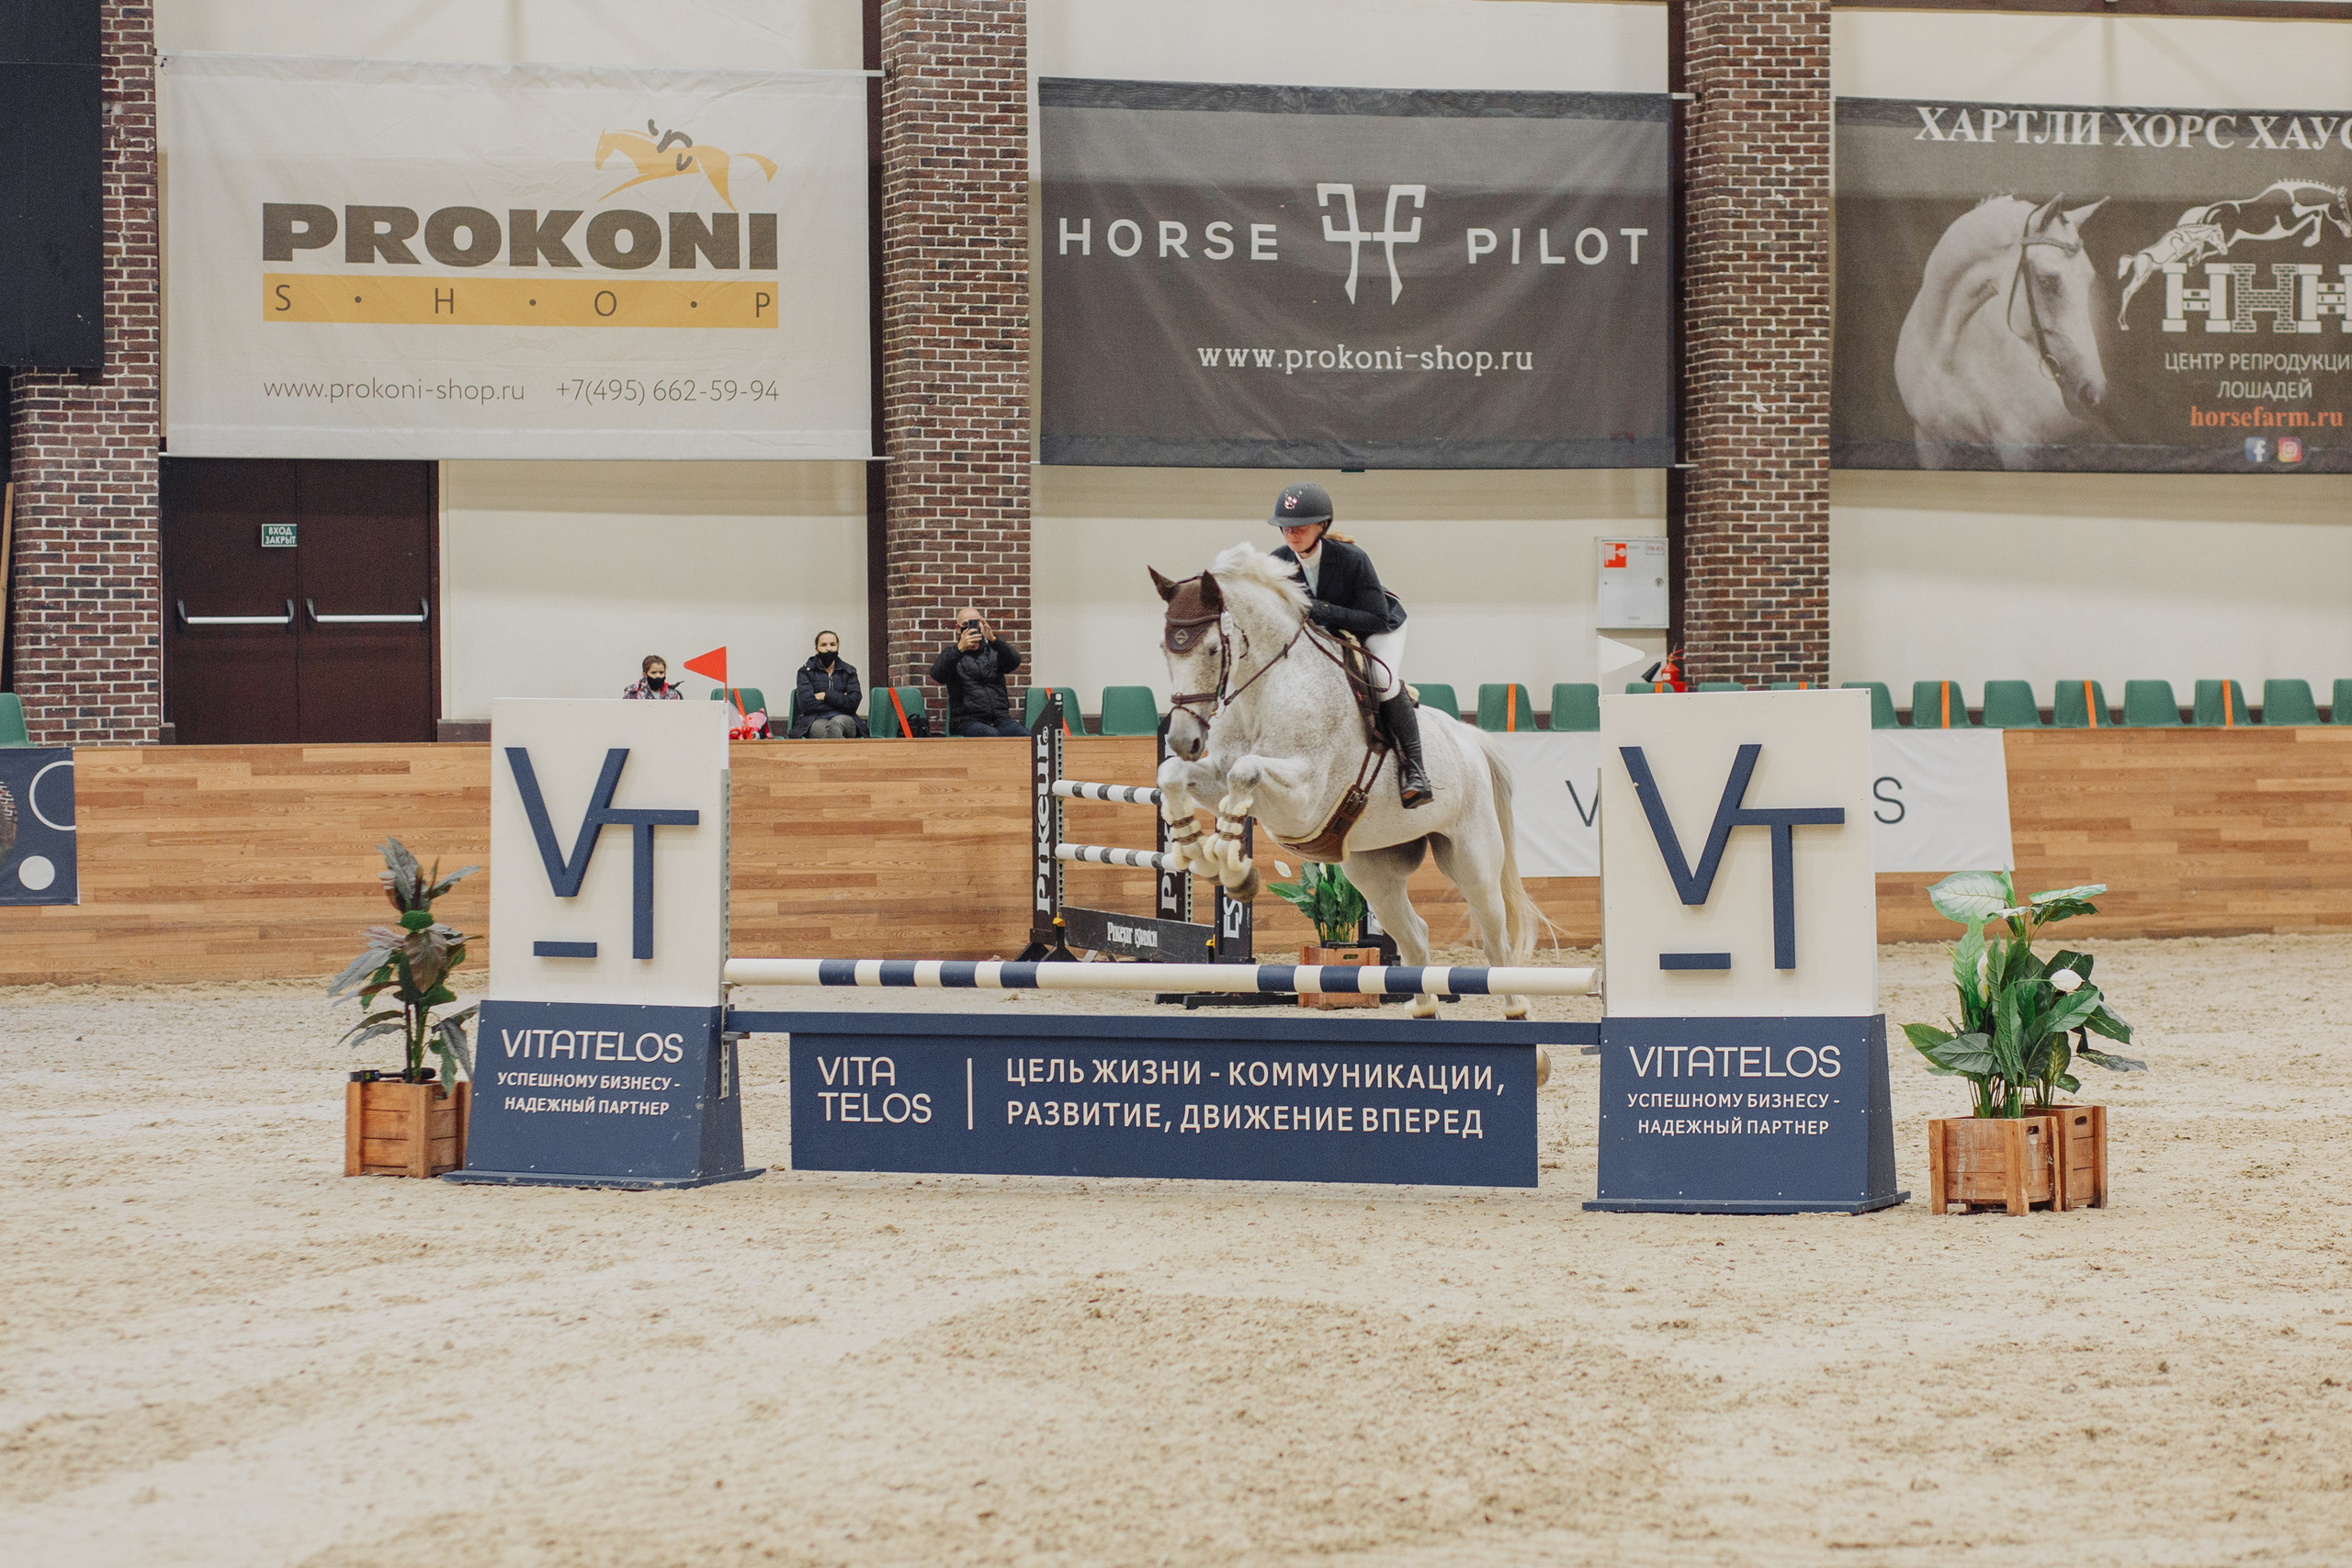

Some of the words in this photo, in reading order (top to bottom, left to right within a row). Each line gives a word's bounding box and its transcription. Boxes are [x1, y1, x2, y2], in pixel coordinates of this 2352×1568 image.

[1915, 107, 2104, 146] ХАРТЛИ
[2113, 113, 2237, 150] ХОРС
[263, 203, 778, 270] PROKONI
[1059, 218, 1279, 261] HORSE
[1467, 228, 1648, 265] PILOT
[1197, 344, 1533, 376] www.prokoni-shop.ru
[2165, 353, 2224, 373] ЦЕНТР
[2230, 353, 2352, 374] РЕПРОДУКЦИ
[264, 378, 525, 405] www.prokoni-shop.ru
[556, 378, 645, 406] +7(495)
[653, 379, 779, 402] 662-59-94
[2217, 378, 2313, 401] ЛОШАДЕЙ
[2190, 406, 2343, 427] horsefarm.ru
[265, 536, 296, 544] ЗАКРЫТ
[268, 526, 293, 536] ВХОД
[502, 1029, 684, 1064] VITATELOS
[1629, 1045, 1841, 1077] VITATELOS
[497, 1071, 598, 1089] УСПЕШНОМУ
[600, 1076, 672, 1090] БИЗНЕСУ
[817, 1056, 896, 1086] VITA
[1007, 1057, 1085, 1087] ЦЕЛЬ
[1092, 1060, 1201, 1085] ЖИЗНИ
[1229, 1061, 1505, 1096] КОММУНИКАЦИИ,
[504, 1097, 595, 1113] НАДЕЖНЫЙ
[598, 1100, 670, 1115] ПАРТНЕР
[817, 1092, 933, 1123] TELOS
[1627, 1093, 1744, 1108] УСПЕШНОМУ
[1747, 1093, 1829, 1108] БИЗНЕСУ
[1007, 1101, 1172, 1134] РАЗВИТИЕ,
[1180, 1104, 1353, 1134] ДВИЖЕНИЕ
[1363, 1107, 1484, 1139] ВПЕРЕД
[1638, 1117, 1742, 1136] НАДЕЖНЫЙ
[1747, 1120, 1829, 1134] ПАРТНЕР
